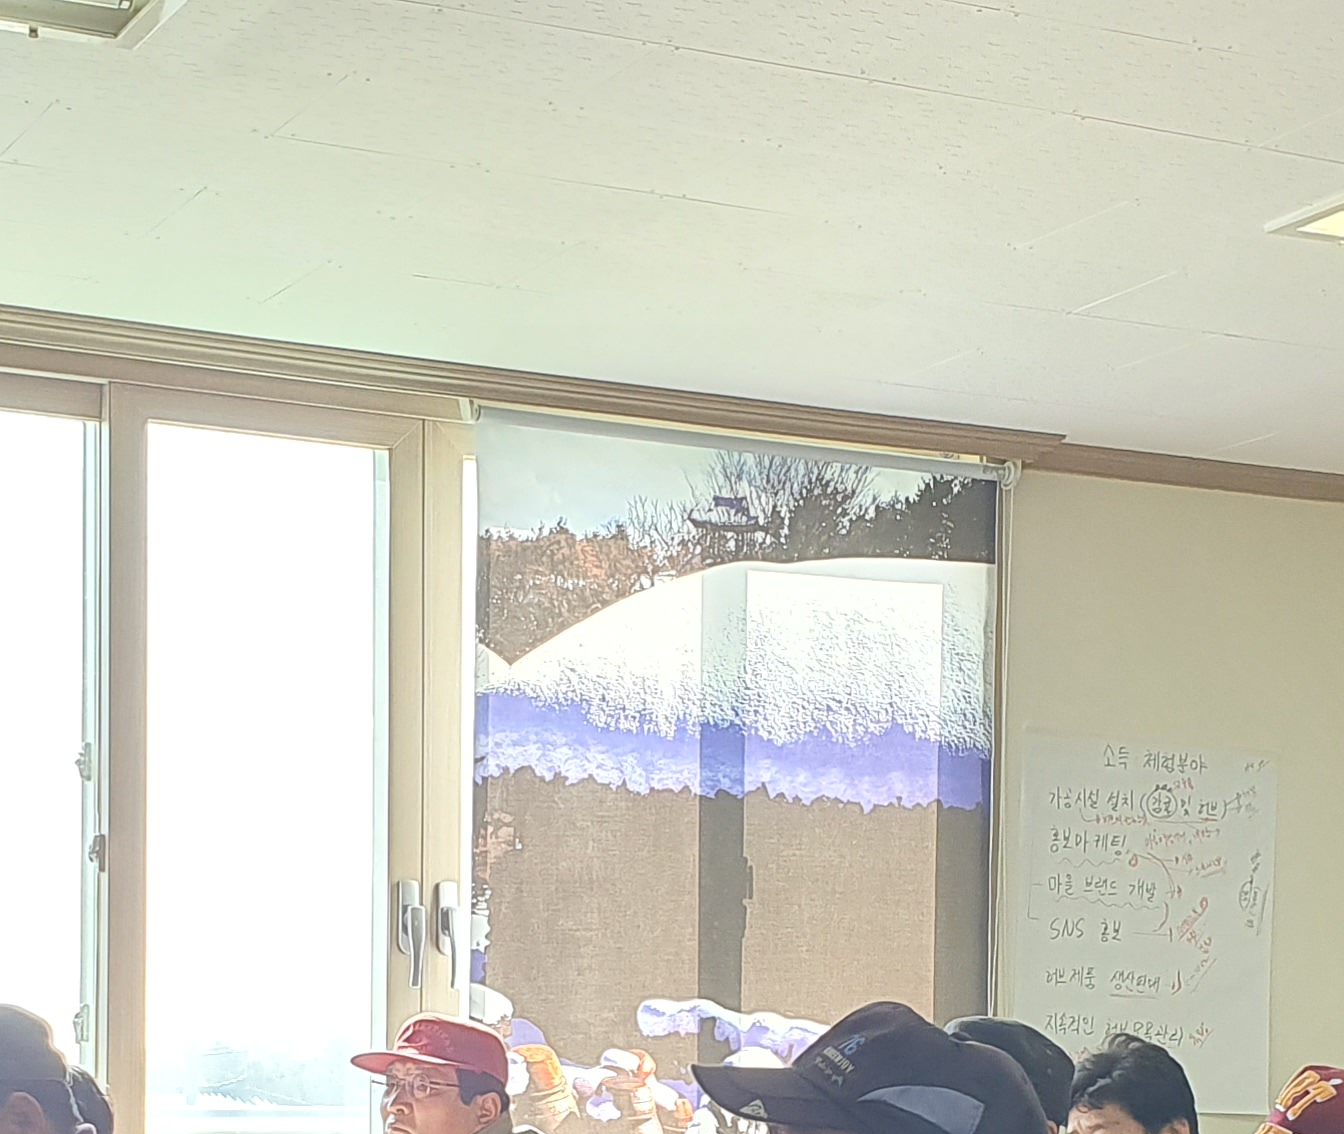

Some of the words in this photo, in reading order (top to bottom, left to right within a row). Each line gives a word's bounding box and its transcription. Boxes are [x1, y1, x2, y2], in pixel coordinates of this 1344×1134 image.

[1103, 744, 1130, 770] 소득
[1049, 786, 1100, 810] 가공시설
[1048, 873, 1074, 896] 마을
[1083, 875, 1118, 896] 브랜드
[1129, 878, 1157, 902] 개발
[1049, 917, 1085, 940] SNS
[1100, 918, 1123, 943] 홍보
